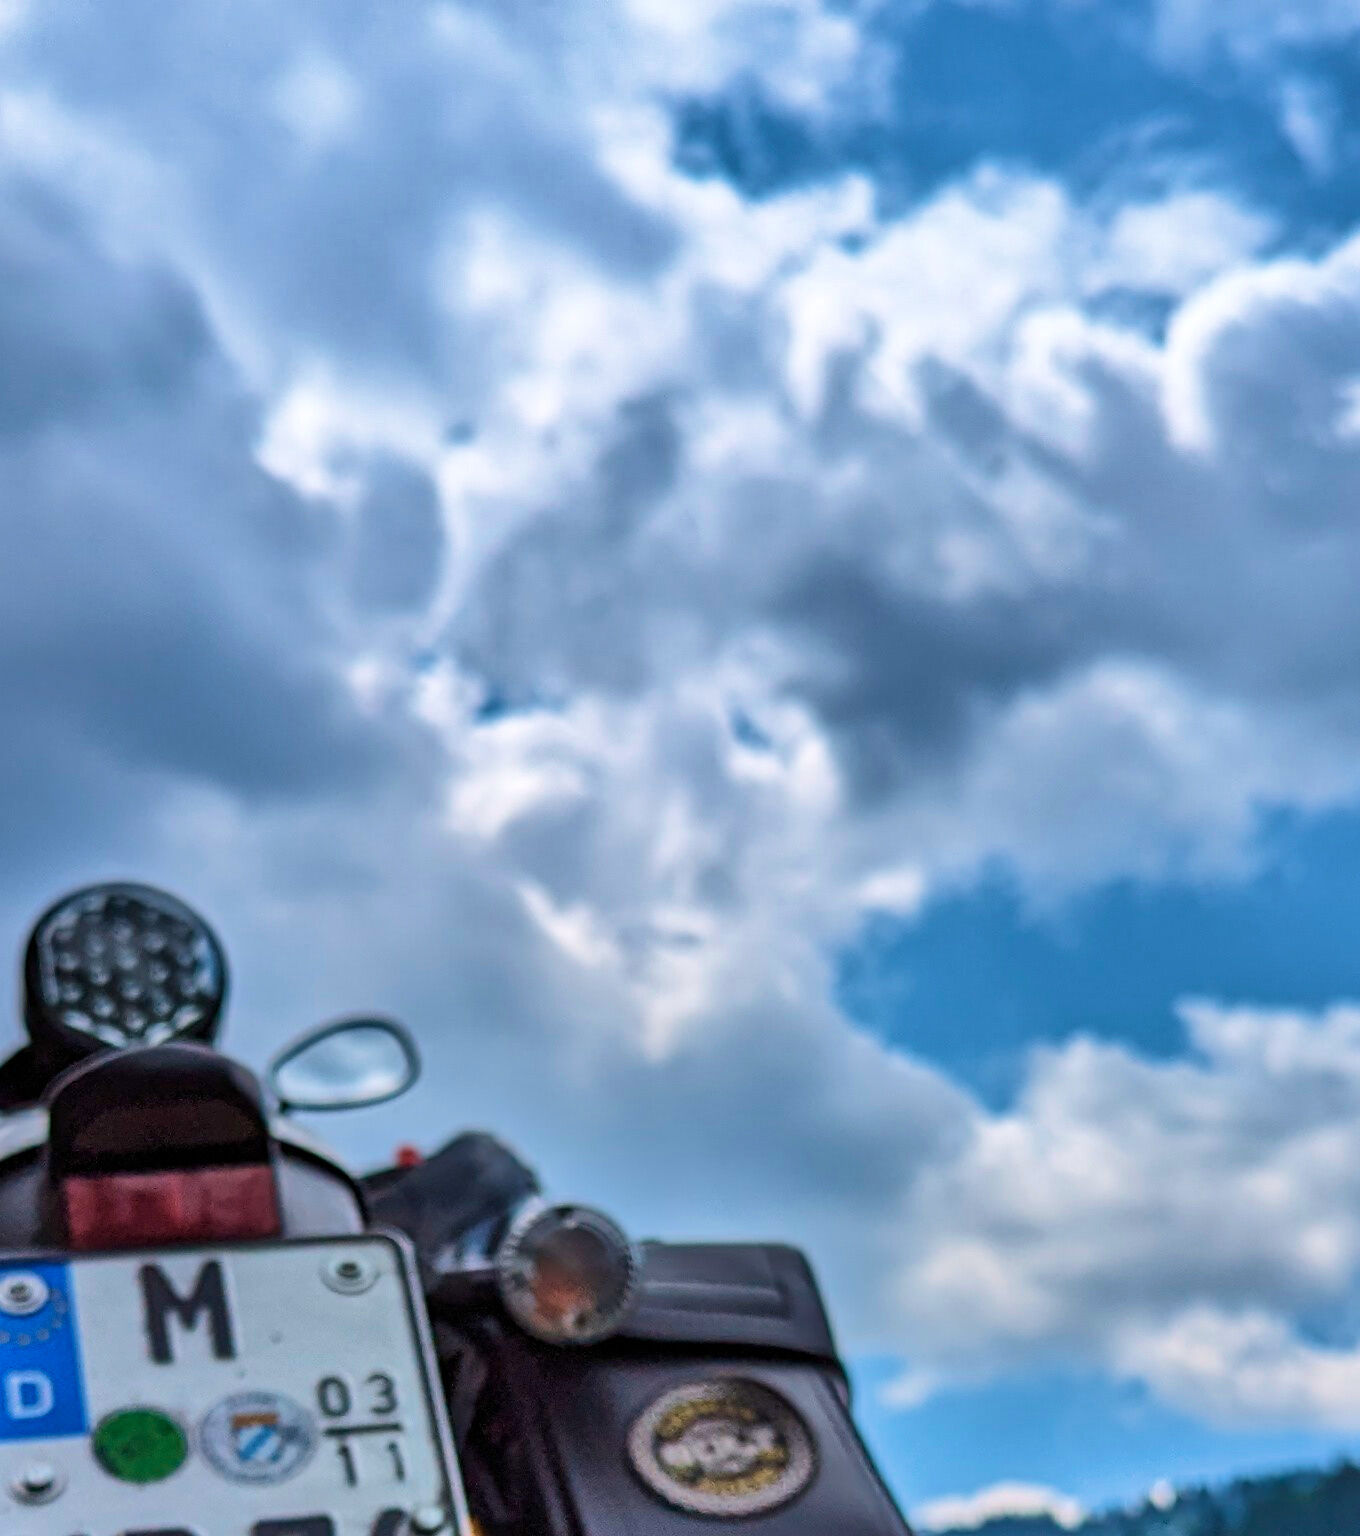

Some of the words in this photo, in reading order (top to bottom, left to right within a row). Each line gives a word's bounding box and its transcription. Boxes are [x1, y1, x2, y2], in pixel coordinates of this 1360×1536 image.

[140, 1260, 239, 1364] M
[3, 1371, 54, 1419] D
[317, 1374, 398, 1417] 03
